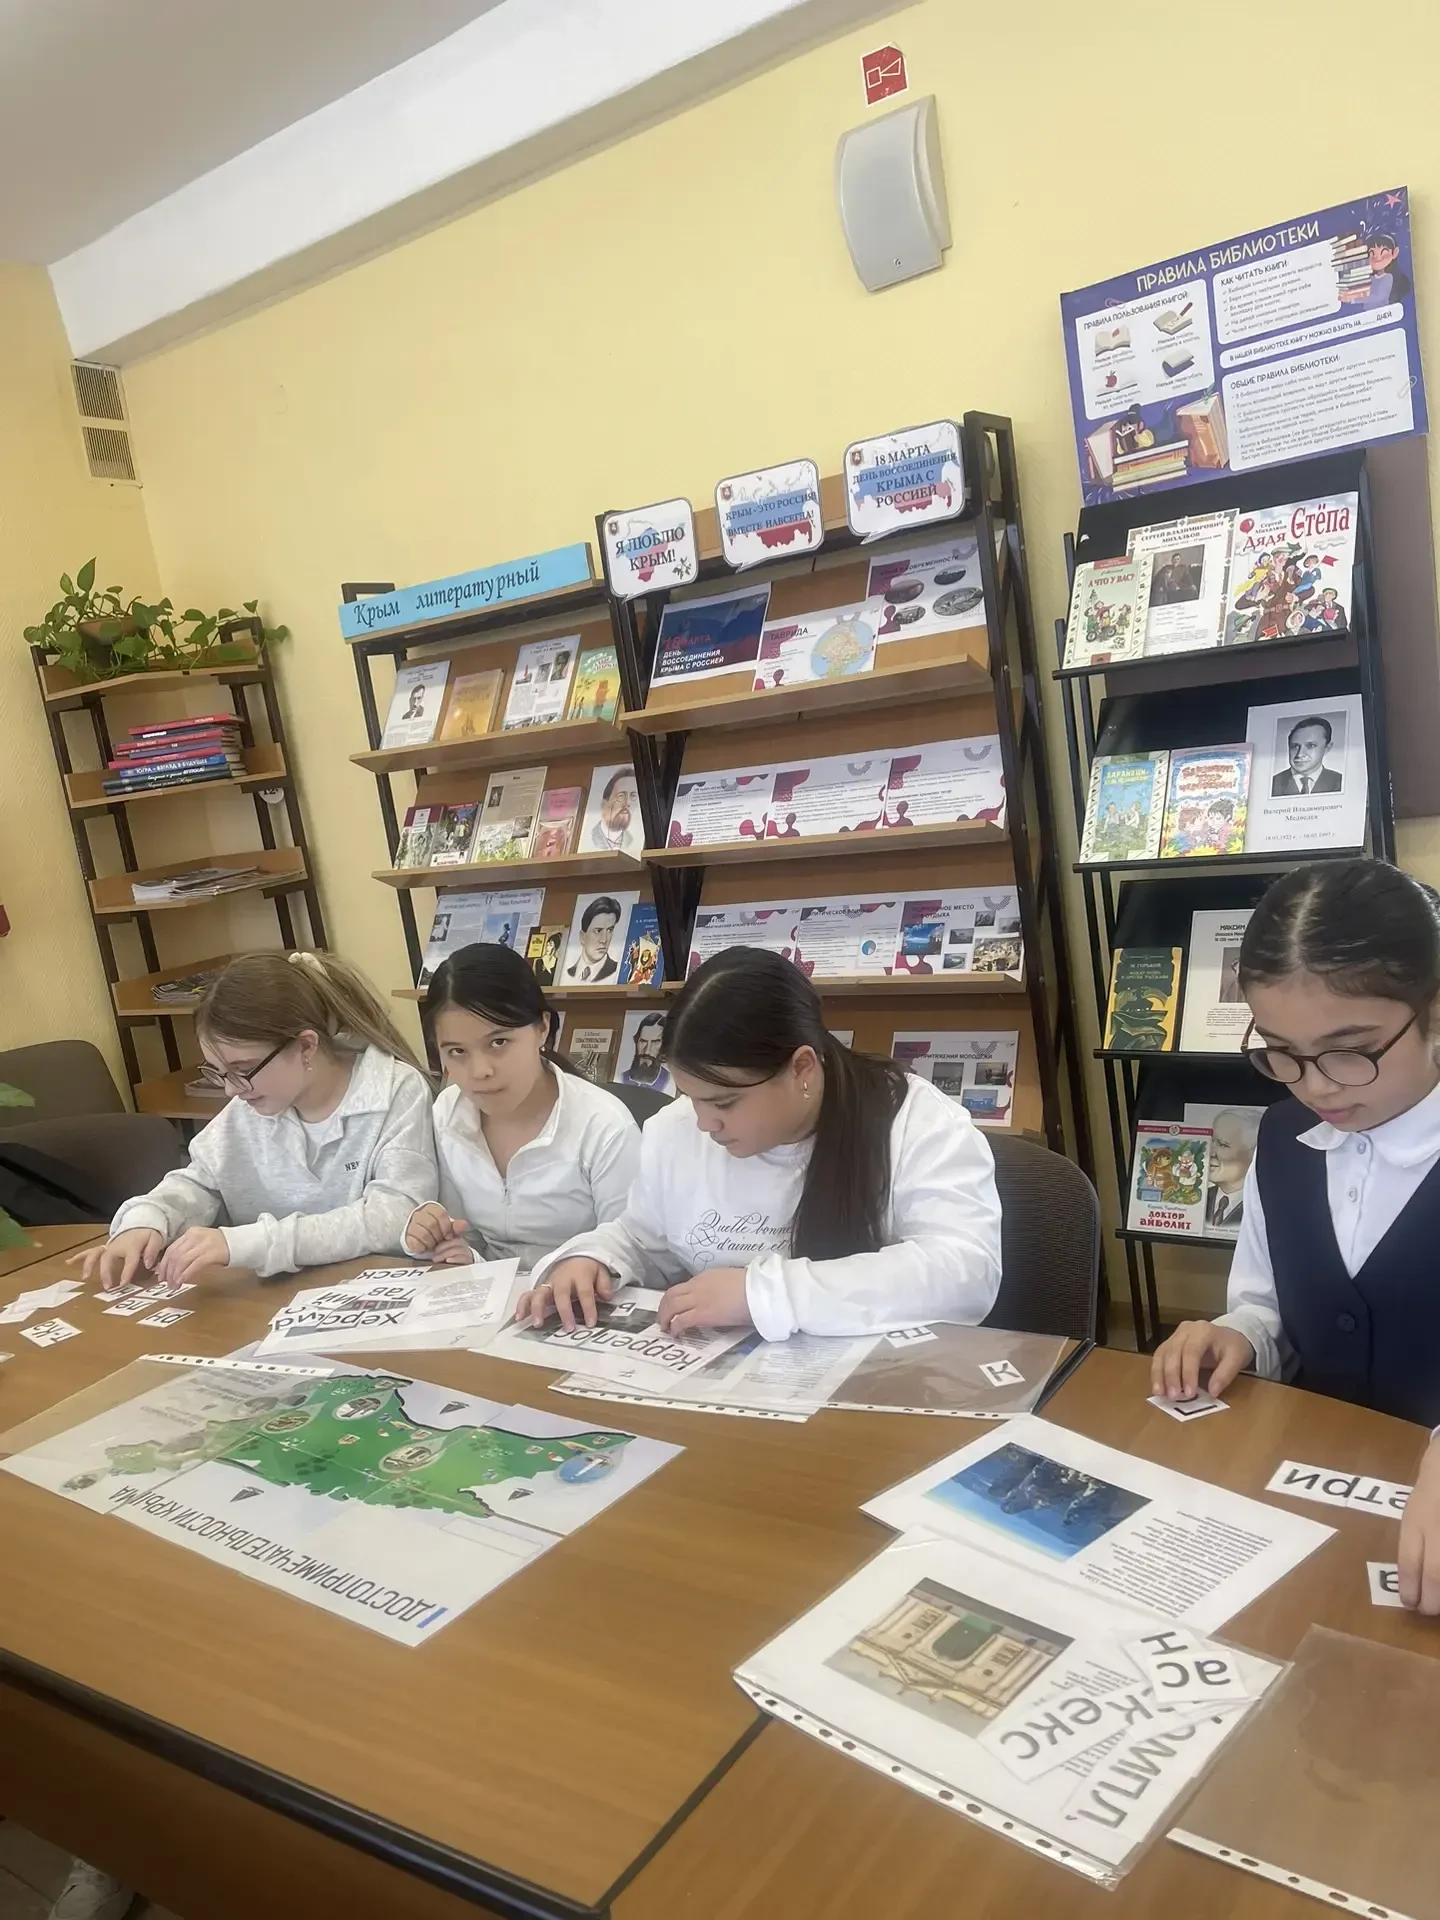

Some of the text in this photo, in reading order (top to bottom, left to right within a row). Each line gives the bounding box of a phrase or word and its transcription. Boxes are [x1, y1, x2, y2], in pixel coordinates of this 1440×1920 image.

[1136, 221, 1319, 292] ПРАВИЛА БИБЛИОТЕКИ
[1221, 276, 1233, 286] КАК
[1236, 268, 1263, 282] ЧИТАТЬ
[1084, 316, 1112, 330] ПРАВИЛА
[1112, 302, 1160, 320] ПОЛЬЗОВАНИЯ
[1308, 327, 1332, 339] МОЖНО
[1229, 376, 1256, 390] ОБЩИЕ
[1255, 367, 1289, 383] ПРАВИЛА
[875, 444, 930, 467] 18 МАРТА
[852, 452, 956, 485] ДЕНЬ ВОССОЕДИНЕНИЯ
[876, 470, 935, 493] КРЫМА С
[726, 508, 752, 521] КРЫМ
[759, 502, 776, 514] ЭТО
[777, 492, 816, 511] РОССИЯ!
[875, 483, 938, 508] РОССИЕЙ
[728, 510, 814, 537] ВМЕСТЕ НАВСЕГДА!
[1291, 504, 1349, 539] Стёпа
[616, 528, 685, 555] Я ЛЮБЛЮ
[630, 548, 676, 571] КРЫМ!
[1094, 578, 1109, 586] ЧТО
[354, 561, 539, 627] Крым литературный
[771, 627, 808, 640] ТАВРИДА
[660, 664, 684, 673] КРЫМА
[692, 656, 724, 668] РОССИЕЙ
[662, 649, 721, 665] ВОССОЕДИНЕНИЯ
[663, 651, 682, 659] ДЕНЬ
[1293, 805, 1342, 813] Владимирович
[1140, 1217, 1192, 1230] АЙБОЛИТ
[1149, 1211, 1185, 1219] ДОКТОР
[717, 1237, 766, 1251] d'aimer
[108, 1485, 436, 1622] ДОСТОПРИМЕЧАТЕЛЬНОСТИ КРЫМА
[998, 1696, 1104, 1762] екс
